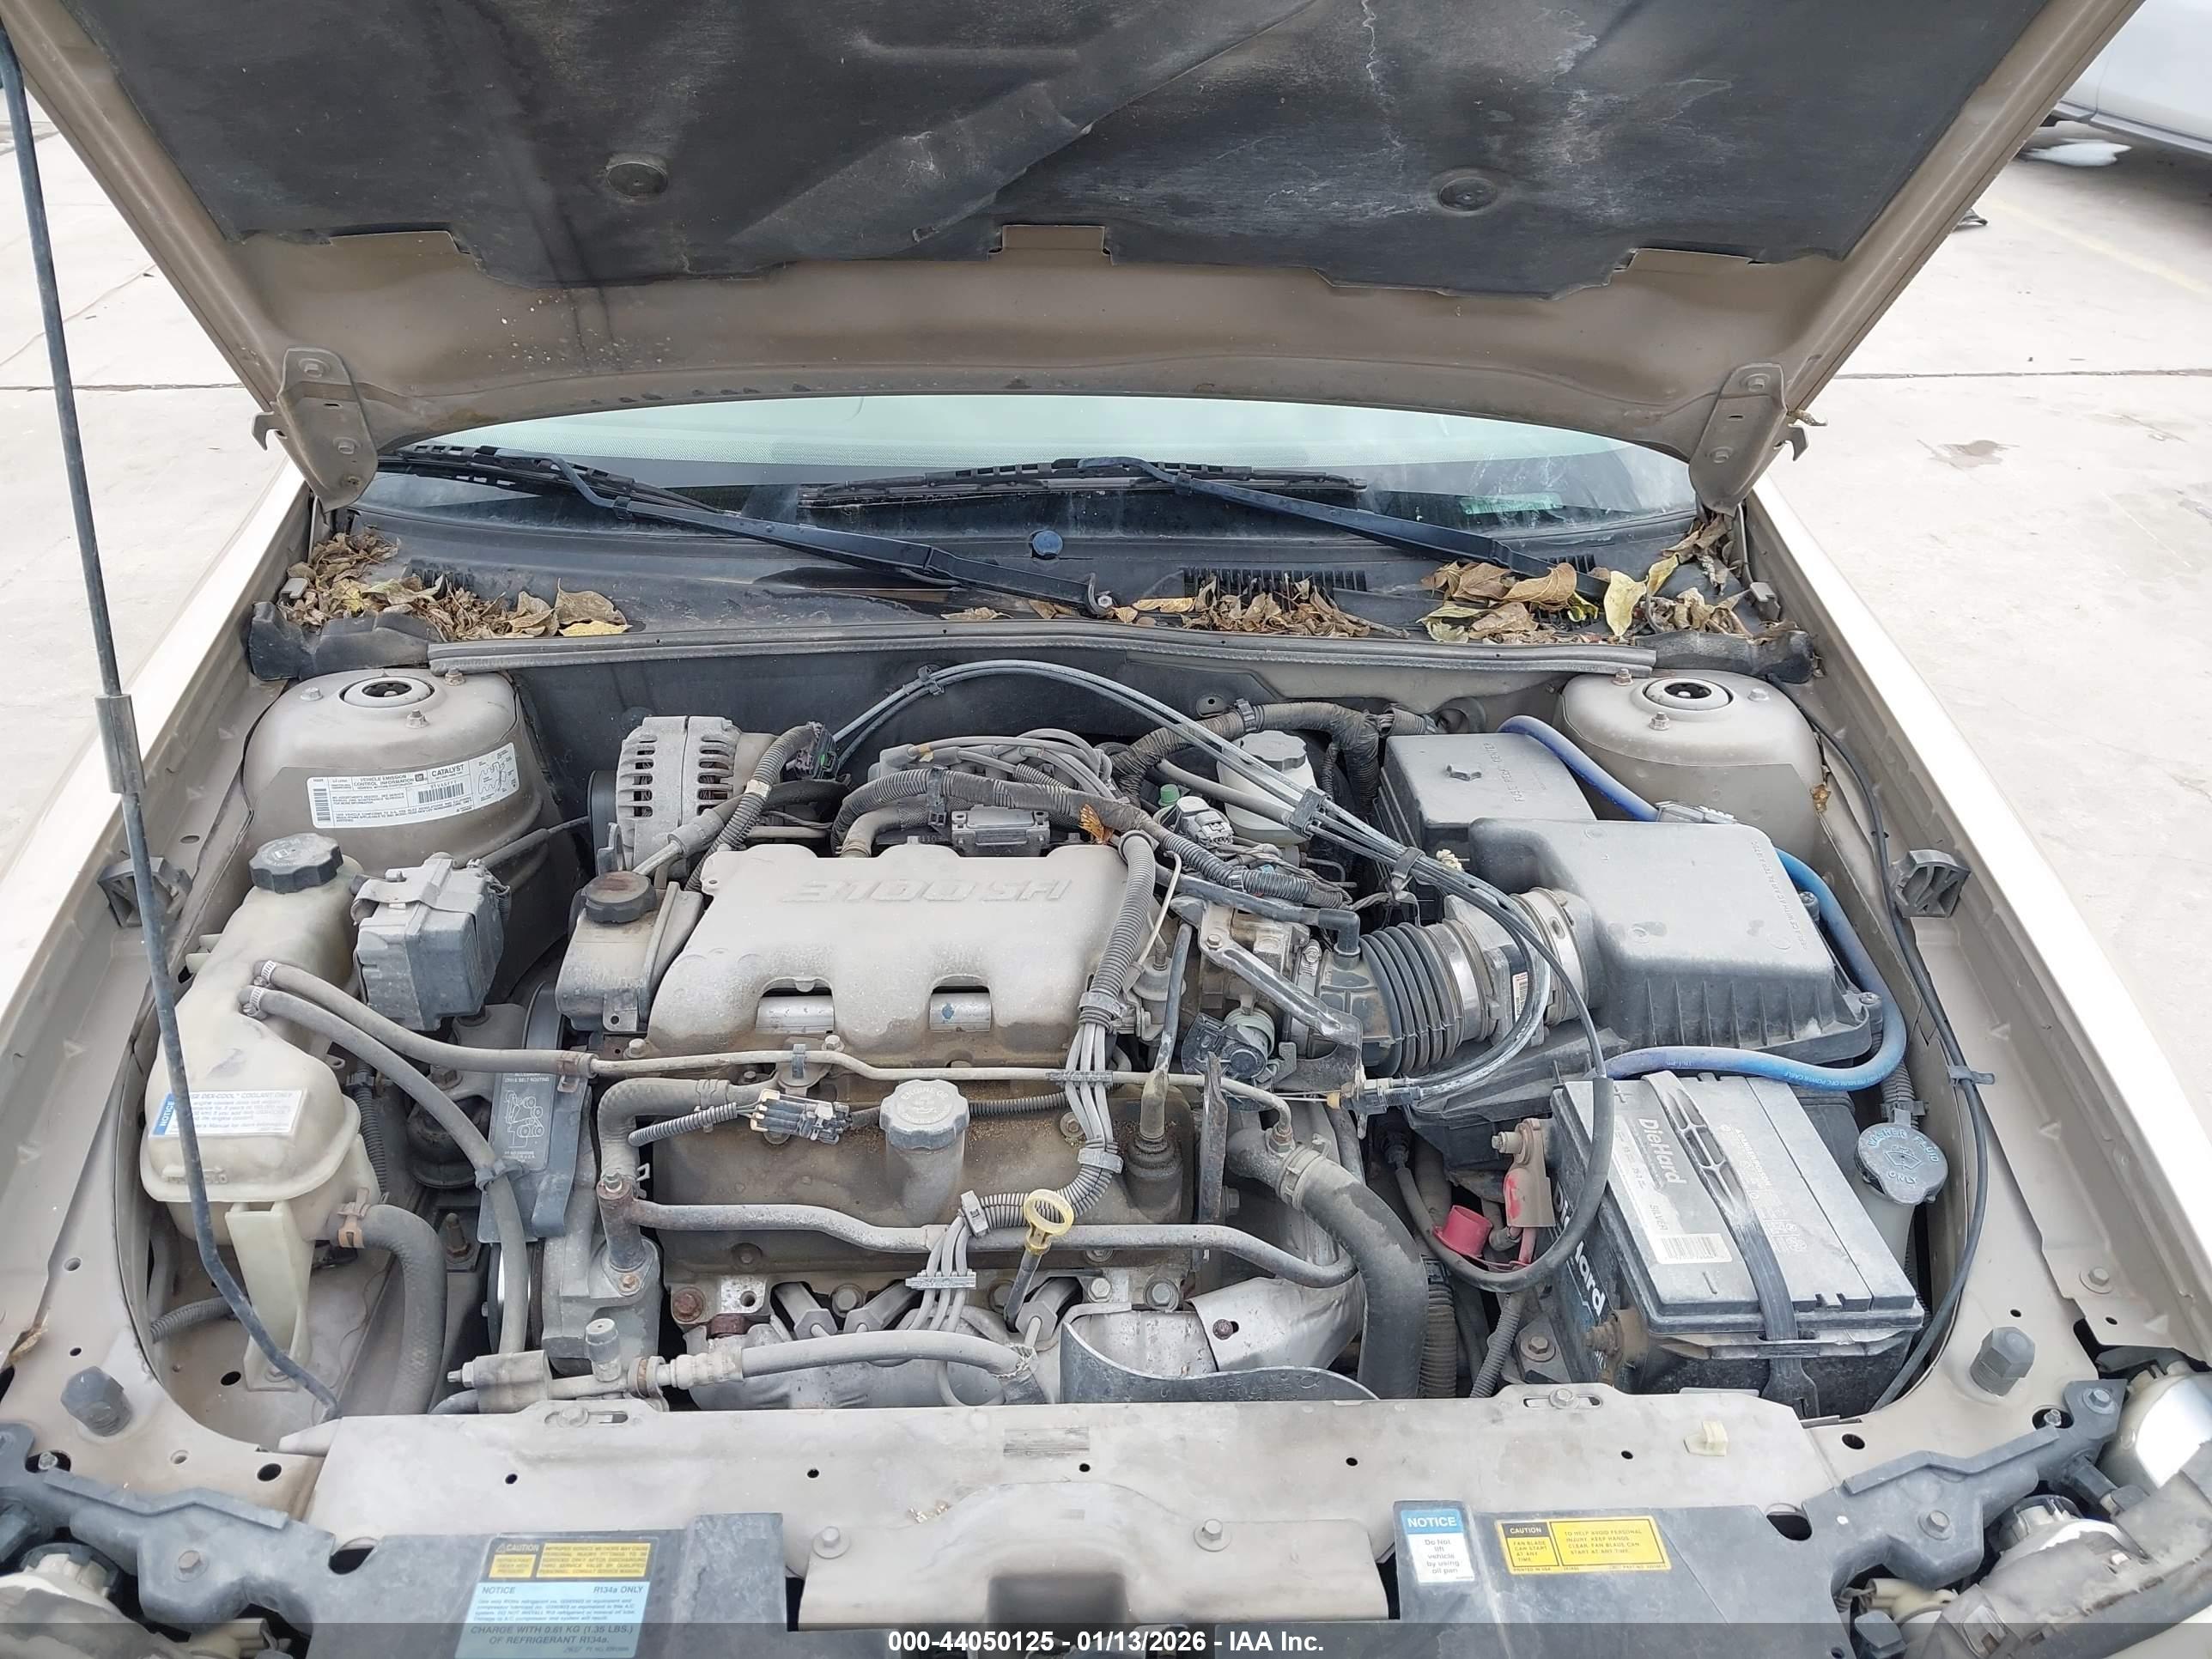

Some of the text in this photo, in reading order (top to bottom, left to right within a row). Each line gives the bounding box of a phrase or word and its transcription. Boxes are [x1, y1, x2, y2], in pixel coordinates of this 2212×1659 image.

[431, 763, 465, 777] CATALYST
[779, 878, 1073, 902] 3100 SFI
[1784, 1071, 1803, 1081] CABLE
[160, 1099, 175, 1127] NOTICE
[1638, 1117, 1688, 1185] DieHard
[1867, 1127, 1940, 1163] WASHER FLUID
[1887, 1170, 1917, 1189] ONLY
[1649, 1204, 1669, 1231] SILVER
[1407, 1516, 1458, 1528] NOTICE
[507, 1543, 539, 1553] CAUTION
[481, 1586, 515, 1595] NOTICE
[620, 1585, 643, 1594] ONLY
[470, 1624, 633, 1635] CHARGE WITH 0.61 KG (1.35 LBS.)
[489, 1636, 504, 1644] OF
